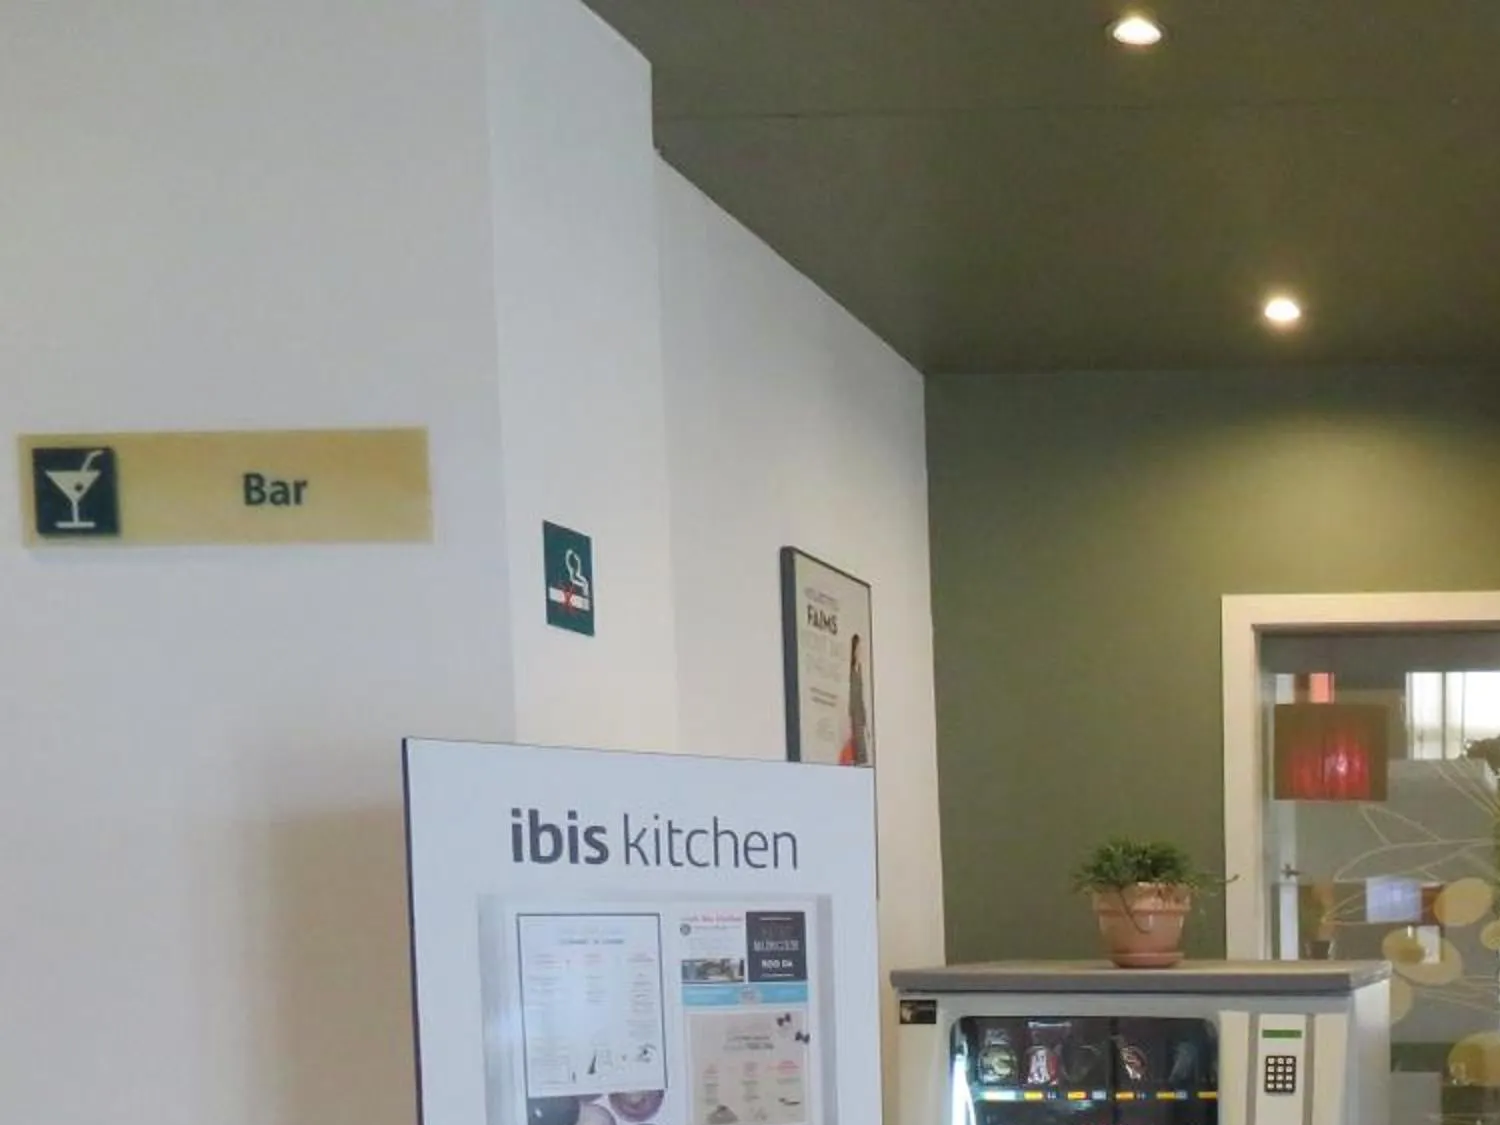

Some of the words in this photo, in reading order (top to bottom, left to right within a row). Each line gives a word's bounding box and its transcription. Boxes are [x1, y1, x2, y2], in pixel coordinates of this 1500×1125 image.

[243, 472, 308, 507] Bar
[510, 807, 610, 865] ibis
[623, 812, 798, 870] kitchen
